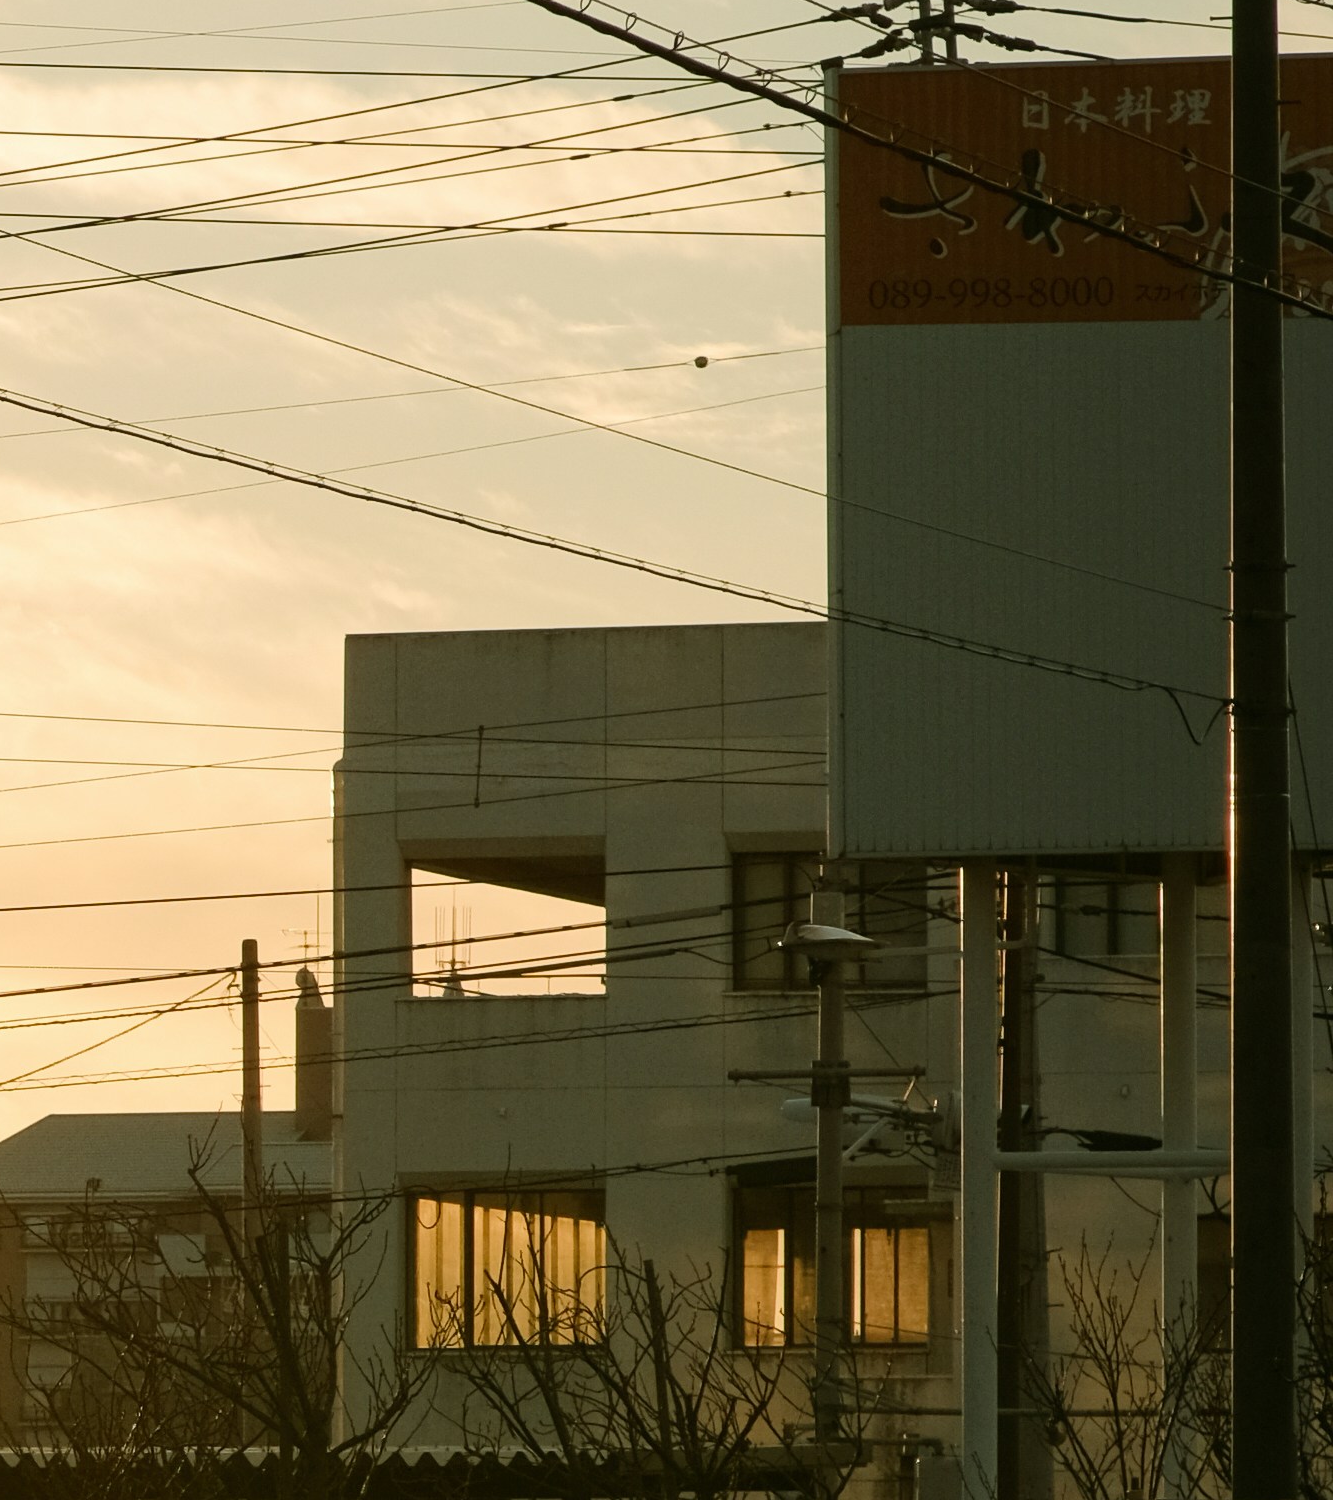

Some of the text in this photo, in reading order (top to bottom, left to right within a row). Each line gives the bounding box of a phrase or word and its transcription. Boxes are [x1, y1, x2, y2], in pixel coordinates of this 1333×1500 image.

[1022, 86, 1214, 134] 日本料理
[868, 277, 1114, 310] 089-998-8000
